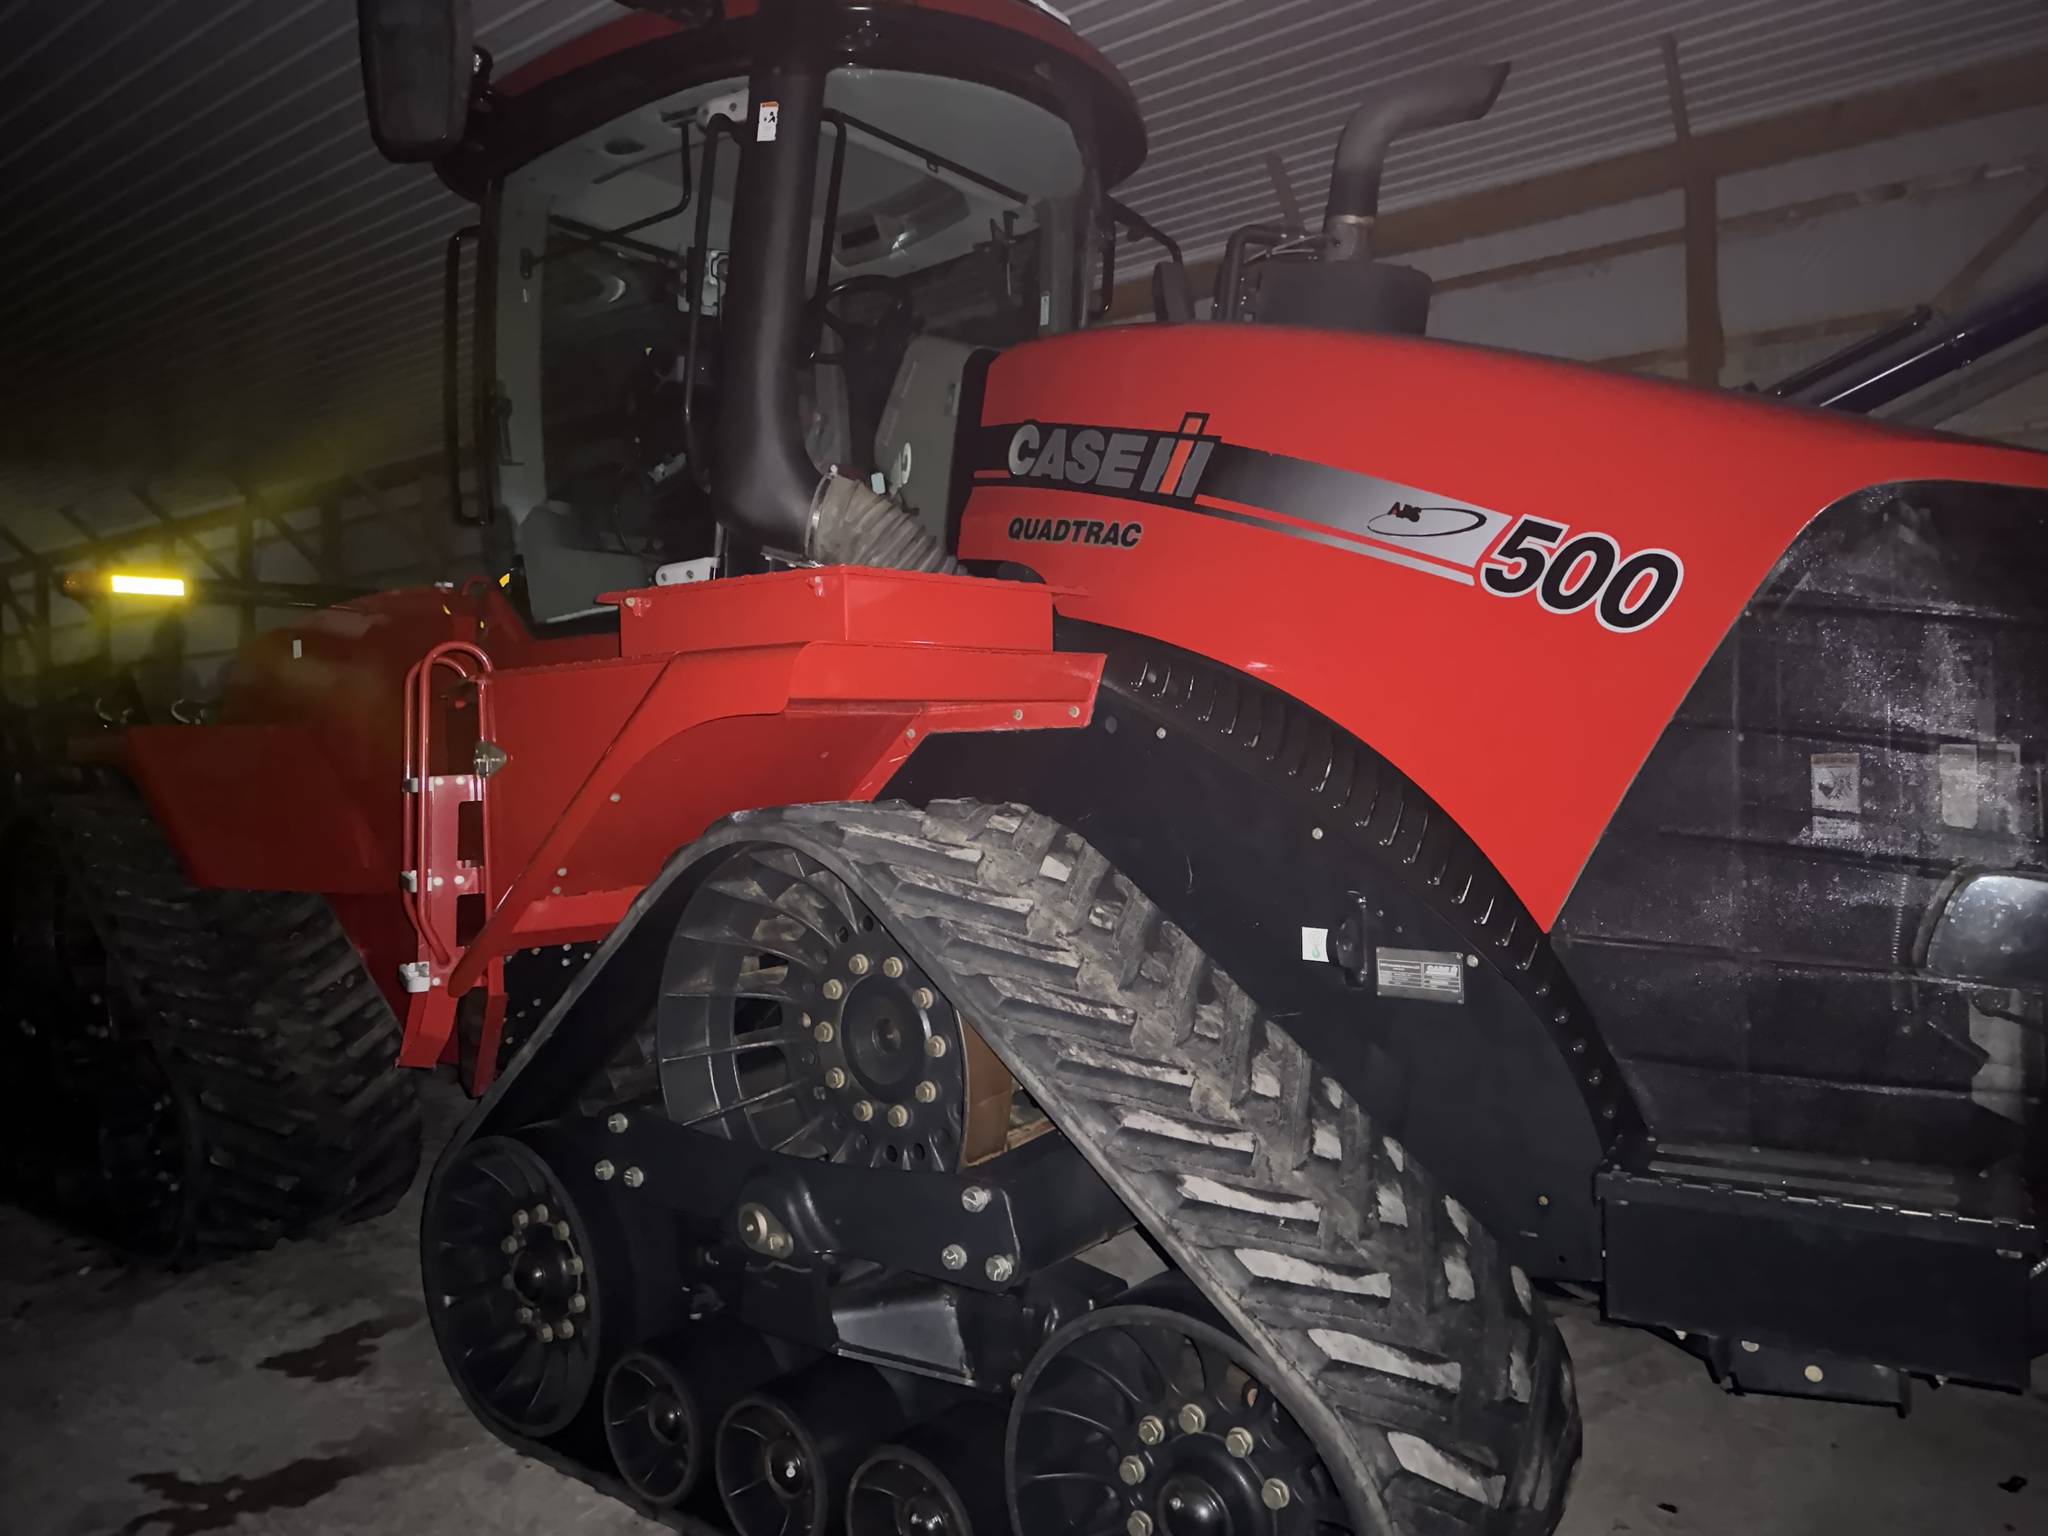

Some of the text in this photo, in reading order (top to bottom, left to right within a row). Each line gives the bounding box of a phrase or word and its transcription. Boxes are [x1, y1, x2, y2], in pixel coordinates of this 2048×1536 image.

[1008, 424, 1148, 489] CASE
[1007, 517, 1142, 548] QUADTRAC
[1482, 515, 1684, 632] 500
